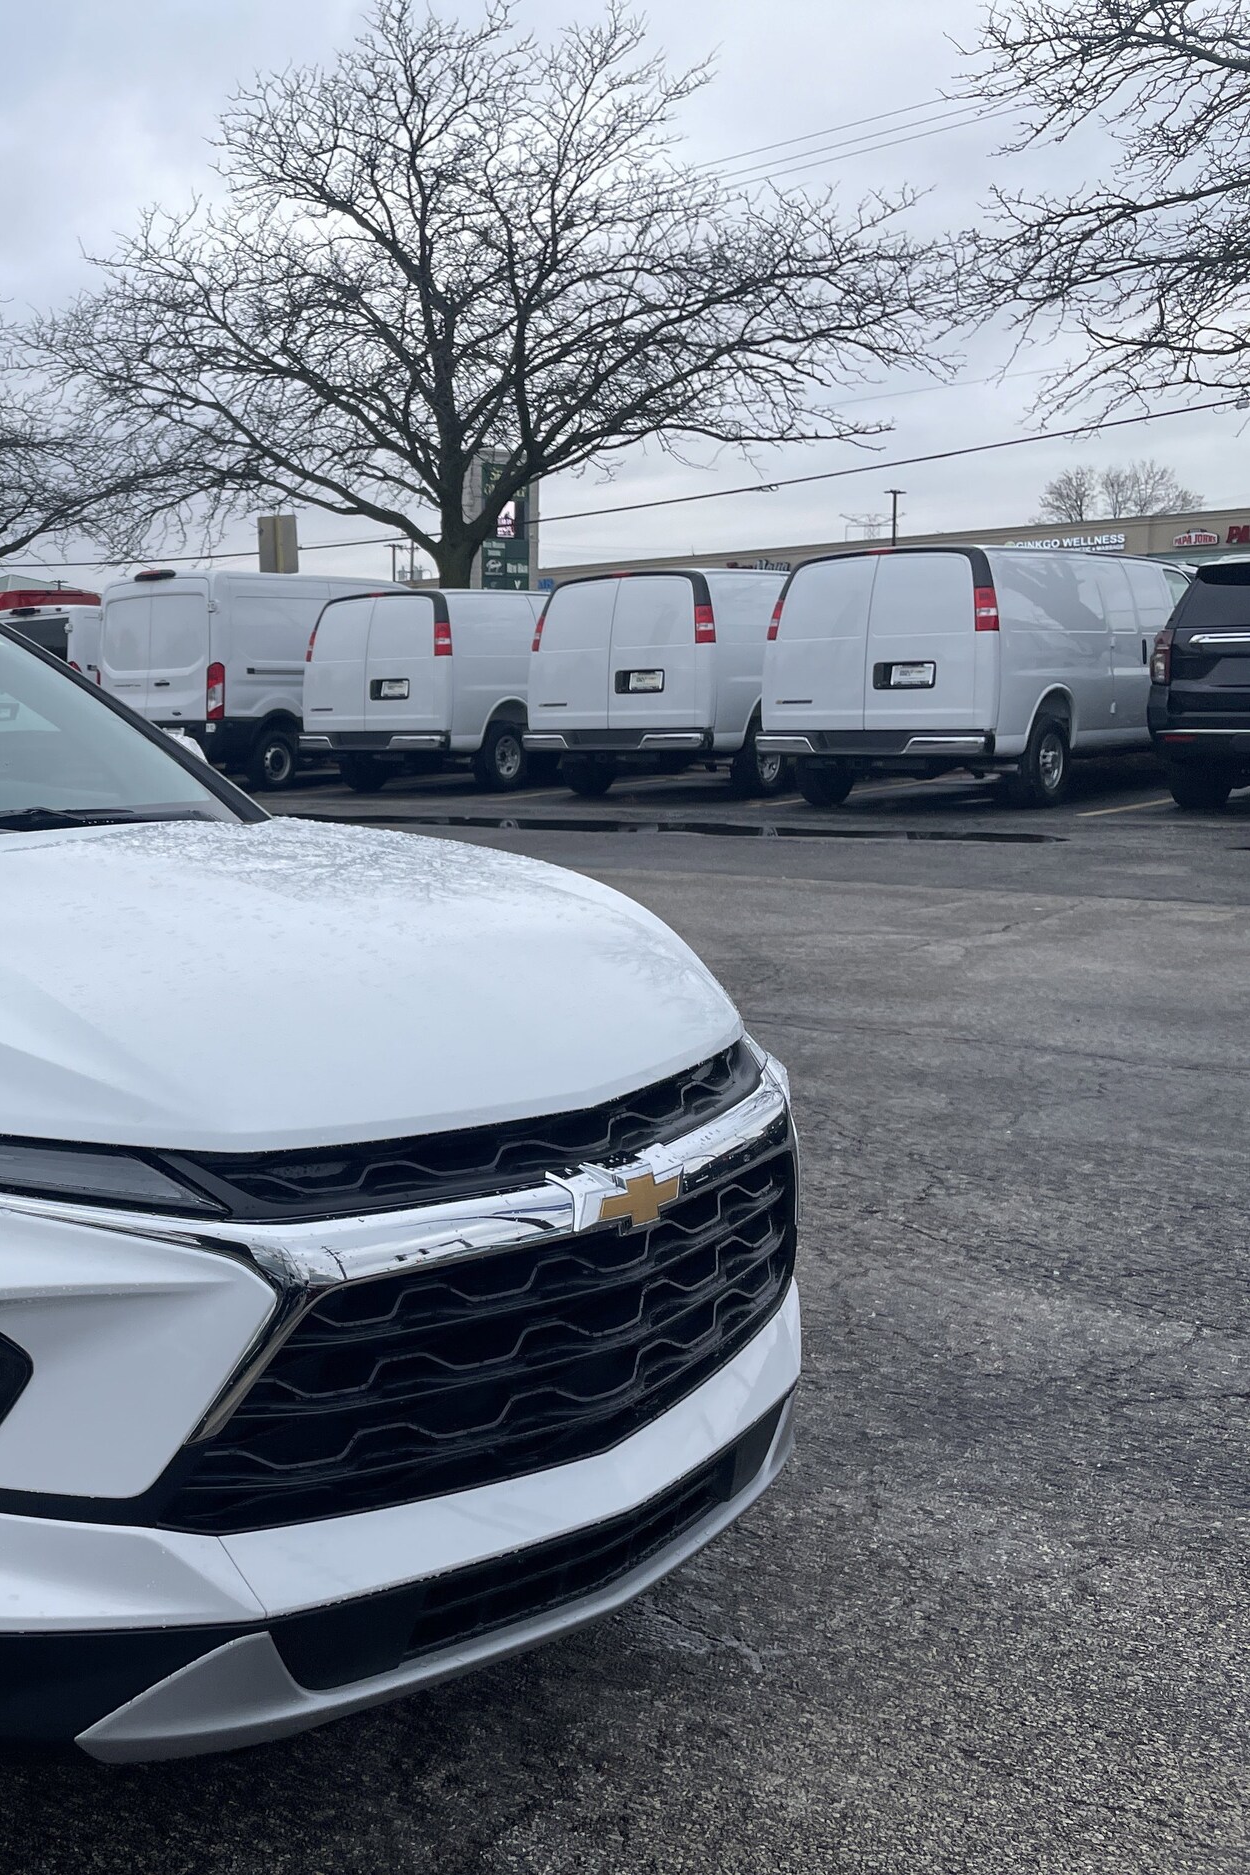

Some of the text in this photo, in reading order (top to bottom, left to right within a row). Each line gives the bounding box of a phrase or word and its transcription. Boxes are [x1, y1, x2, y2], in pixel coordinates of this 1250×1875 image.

[1016, 538, 1060, 549] GINKGO
[1062, 533, 1126, 547] WELLNESS
[1174, 534, 1192, 545] PAPA
